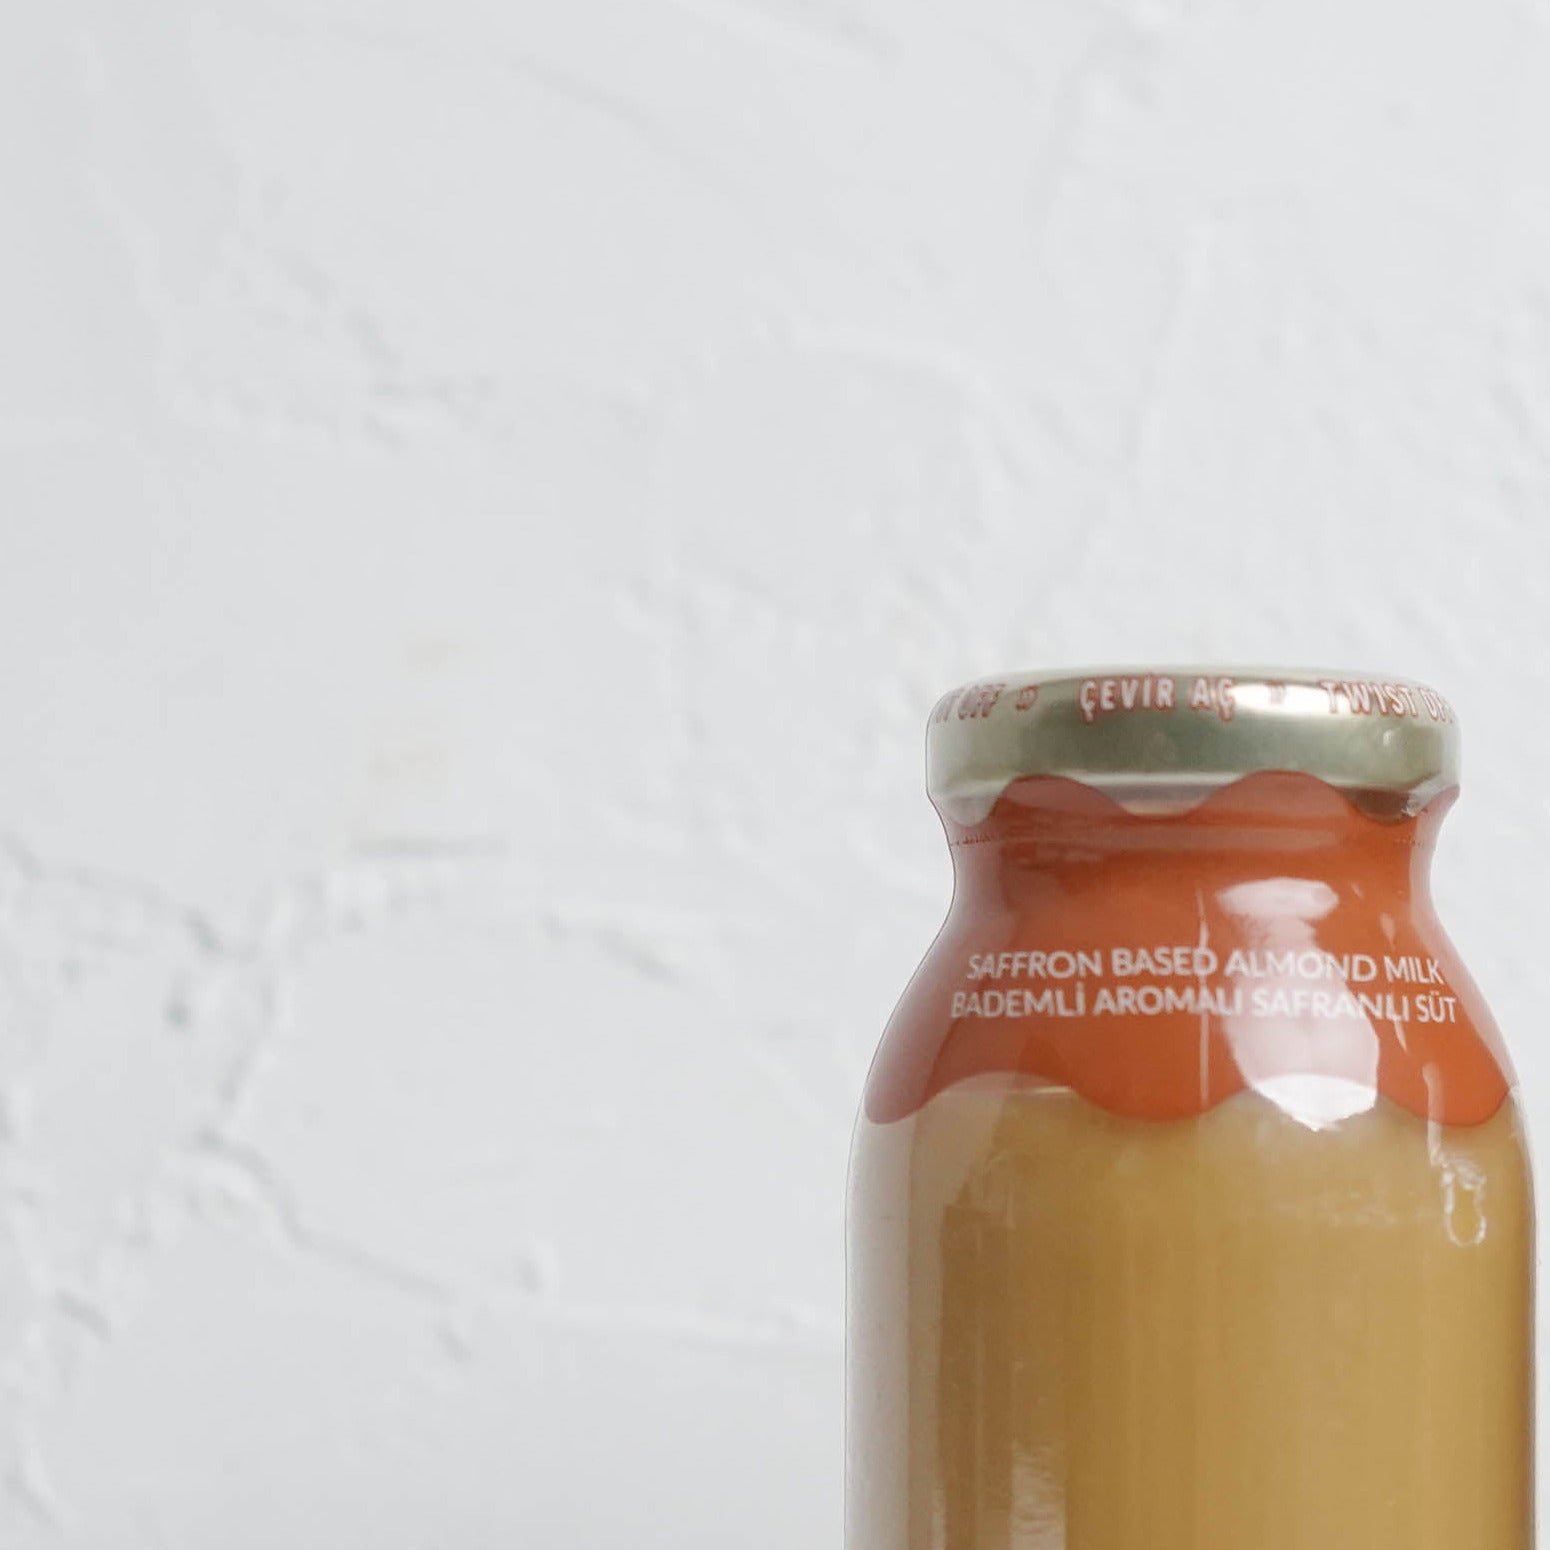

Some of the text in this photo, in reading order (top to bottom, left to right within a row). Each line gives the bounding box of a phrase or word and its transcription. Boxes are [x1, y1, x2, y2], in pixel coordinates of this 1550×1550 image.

[1080, 671, 1175, 723] ÇEVİR
[1190, 677, 1235, 722] AÇ
[1316, 679, 1418, 718] TWIST
[966, 948, 1445, 986] SAFFRON BASED ALMOND MILK
[949, 985, 1458, 1025] BADEMLİ AROMALI SAFRANLI SÜT
